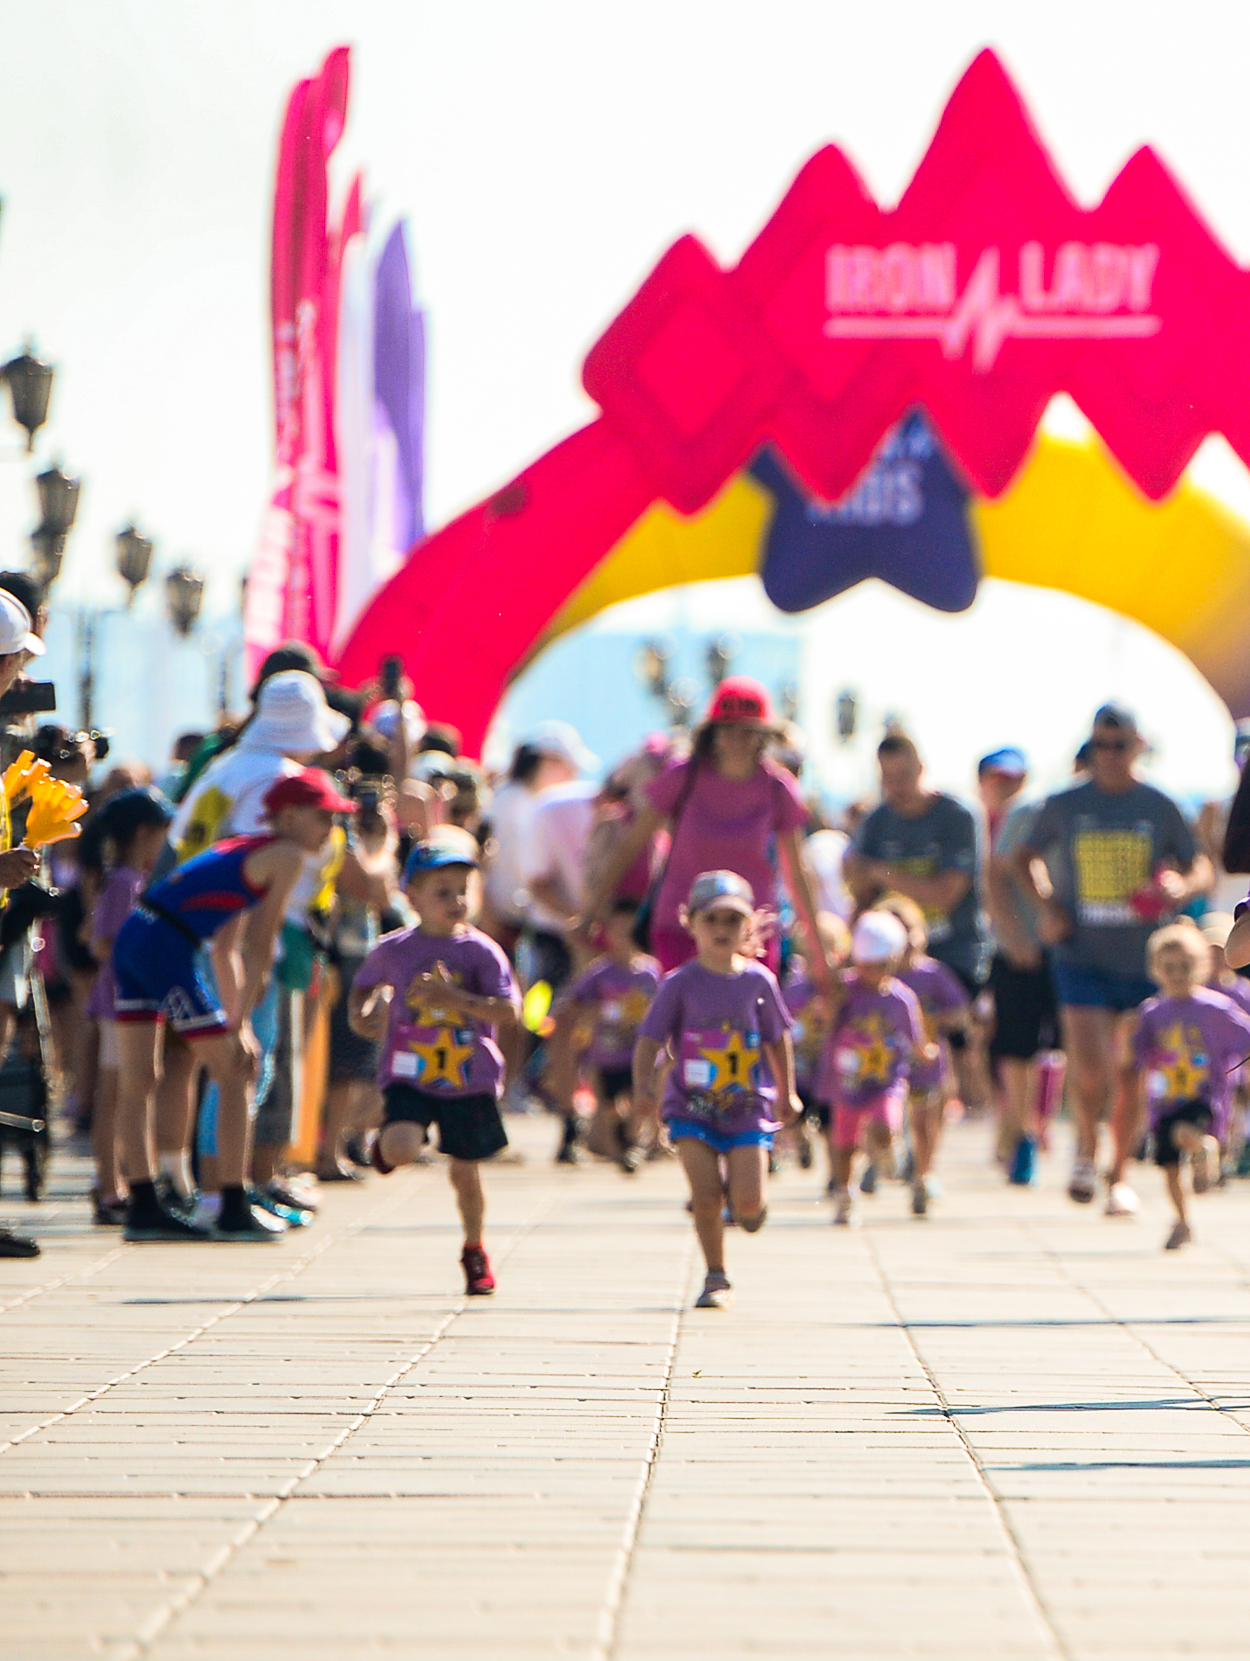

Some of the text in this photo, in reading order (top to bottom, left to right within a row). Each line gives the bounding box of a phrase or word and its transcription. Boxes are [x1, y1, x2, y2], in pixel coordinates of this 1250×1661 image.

[825, 241, 1160, 312] IRON LADY
[436, 1048, 447, 1070] 1
[728, 1053, 738, 1075] 1
